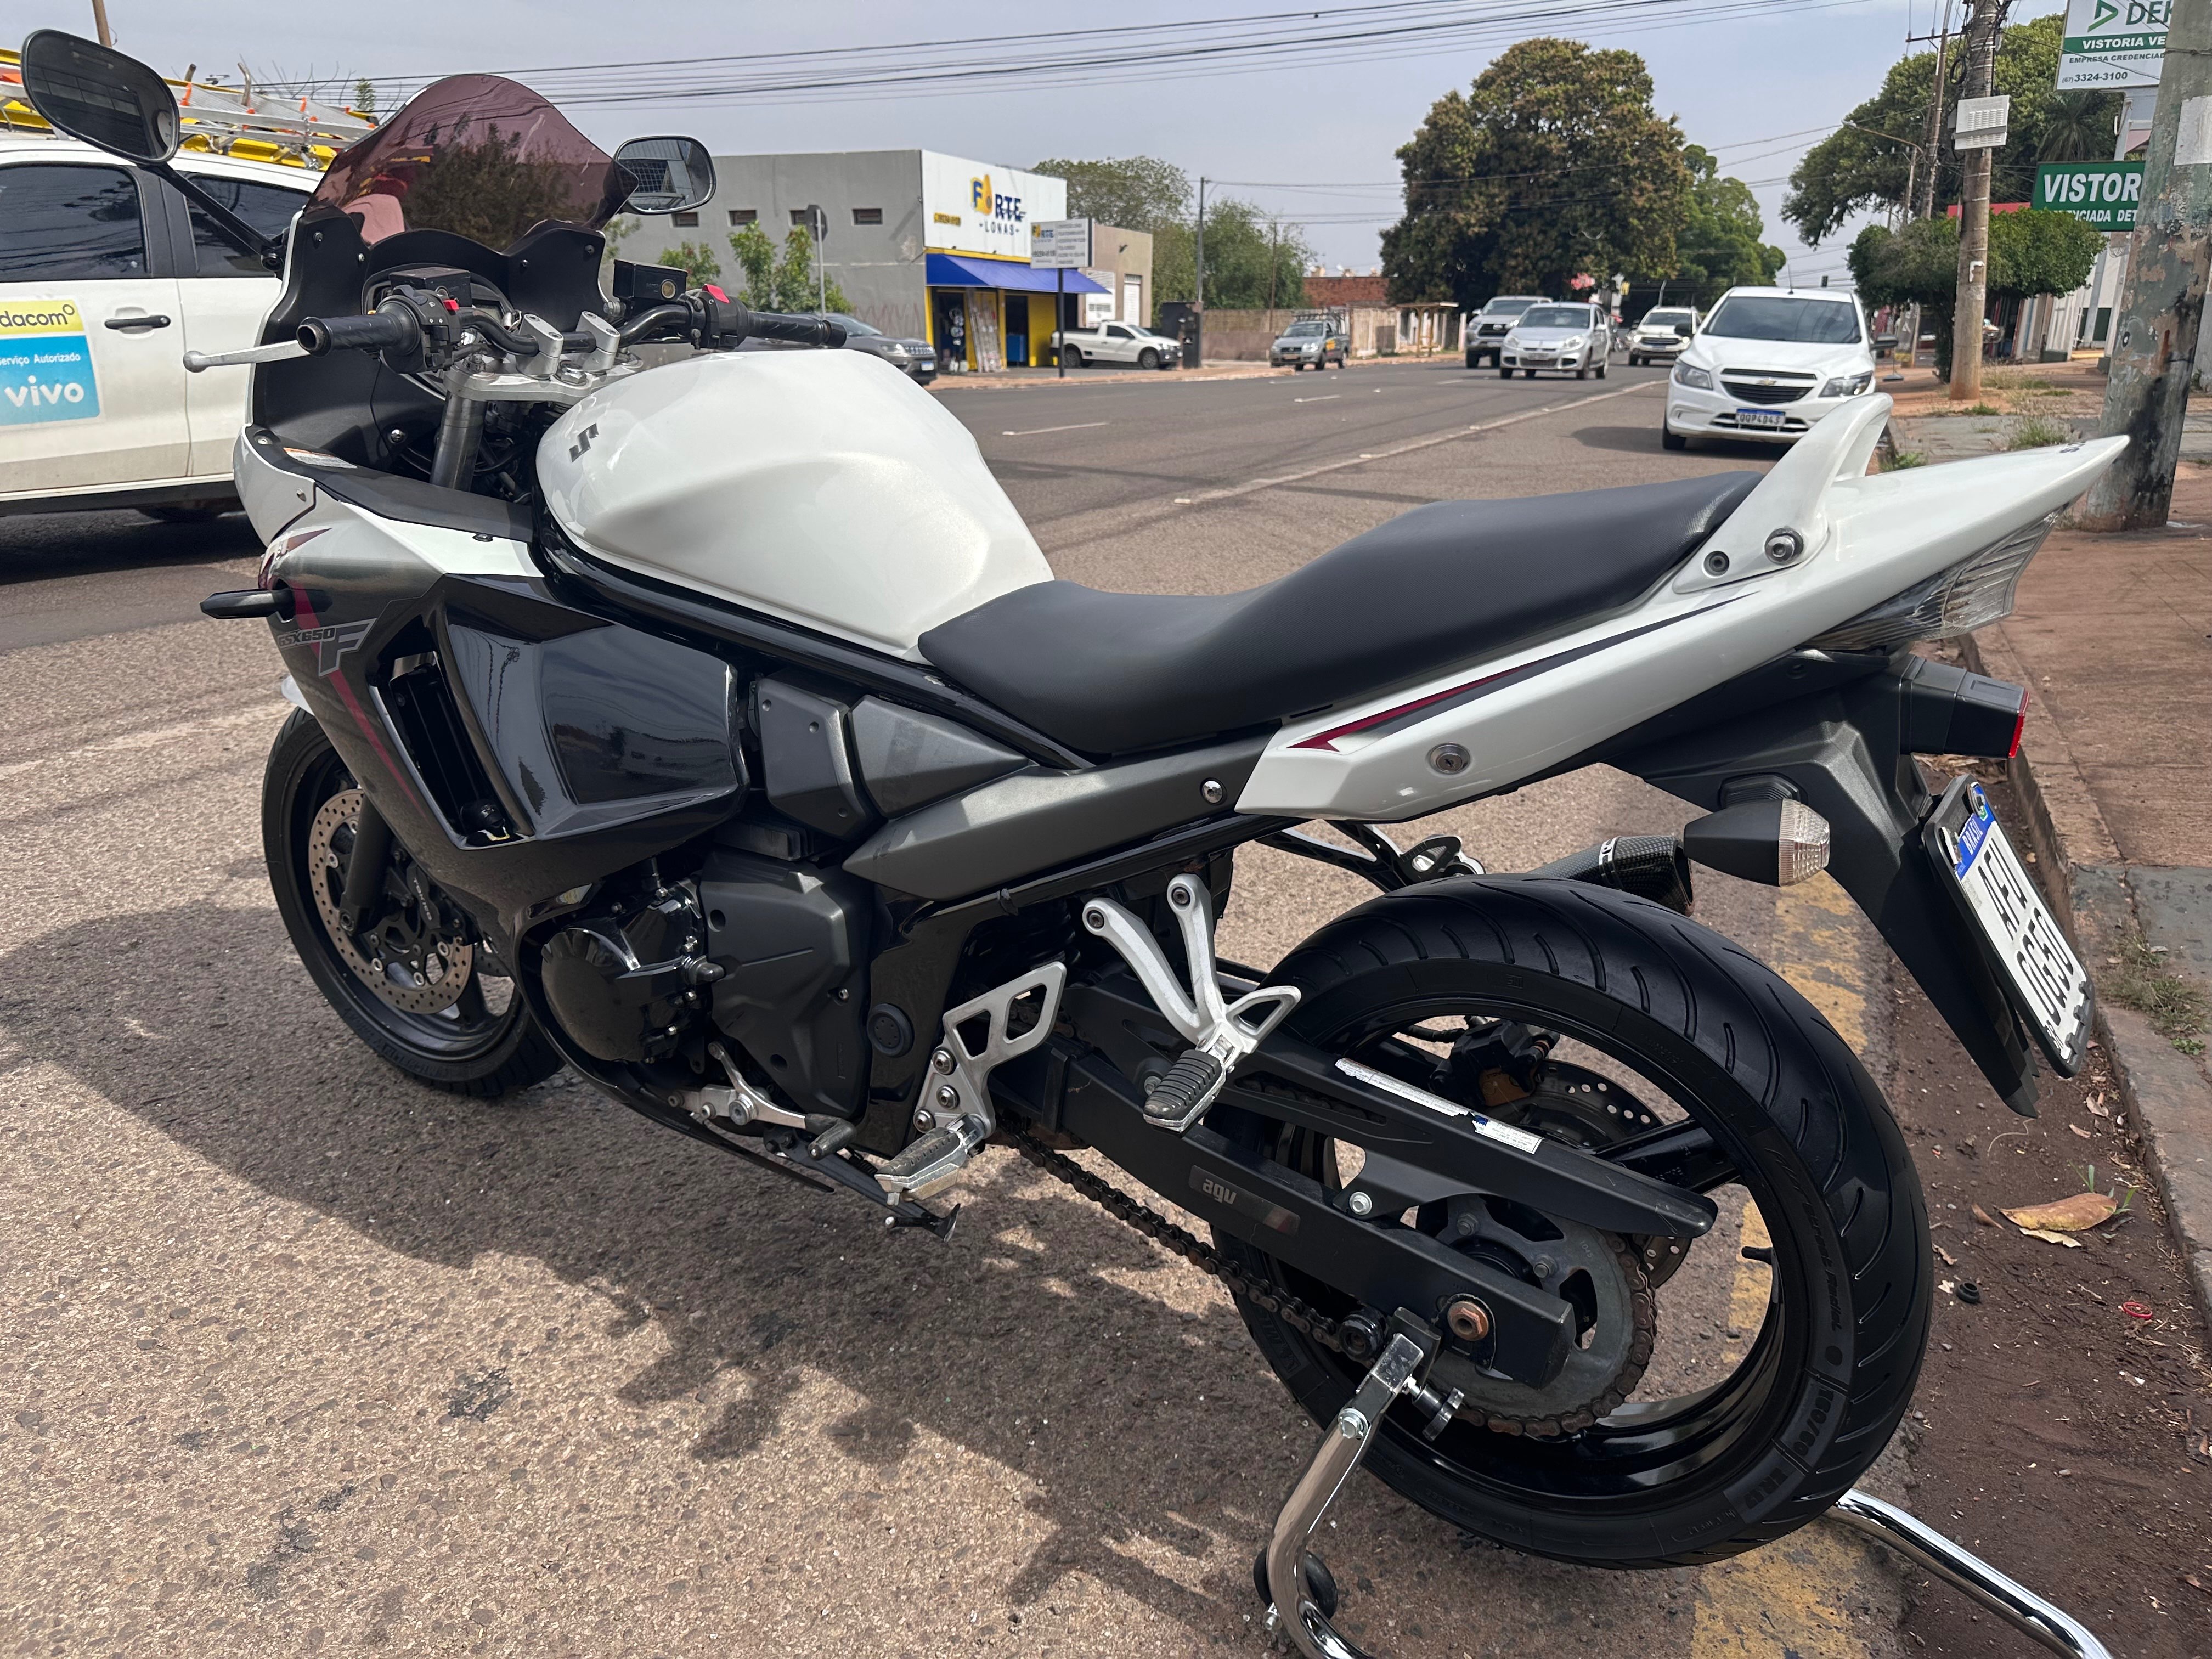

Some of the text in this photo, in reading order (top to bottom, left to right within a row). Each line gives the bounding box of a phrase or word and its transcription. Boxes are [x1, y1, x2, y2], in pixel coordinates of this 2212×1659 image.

[2083, 36, 2166, 49] VISTORIA VE
[2074, 72, 2128, 82] 3324-3100
[973, 174, 1025, 222] FORTE
[2044, 173, 2142, 202] VISTOR
[984, 221, 1015, 235] LONAS
[34, 352, 81, 364] Autorizado
[4, 375, 84, 407] vivo
[1962, 818, 1983, 855] BRASIL
[413, 877, 432, 921] TOKICO
[1978, 837, 2028, 941] AFU
[1203, 1178, 1237, 1205] agv
